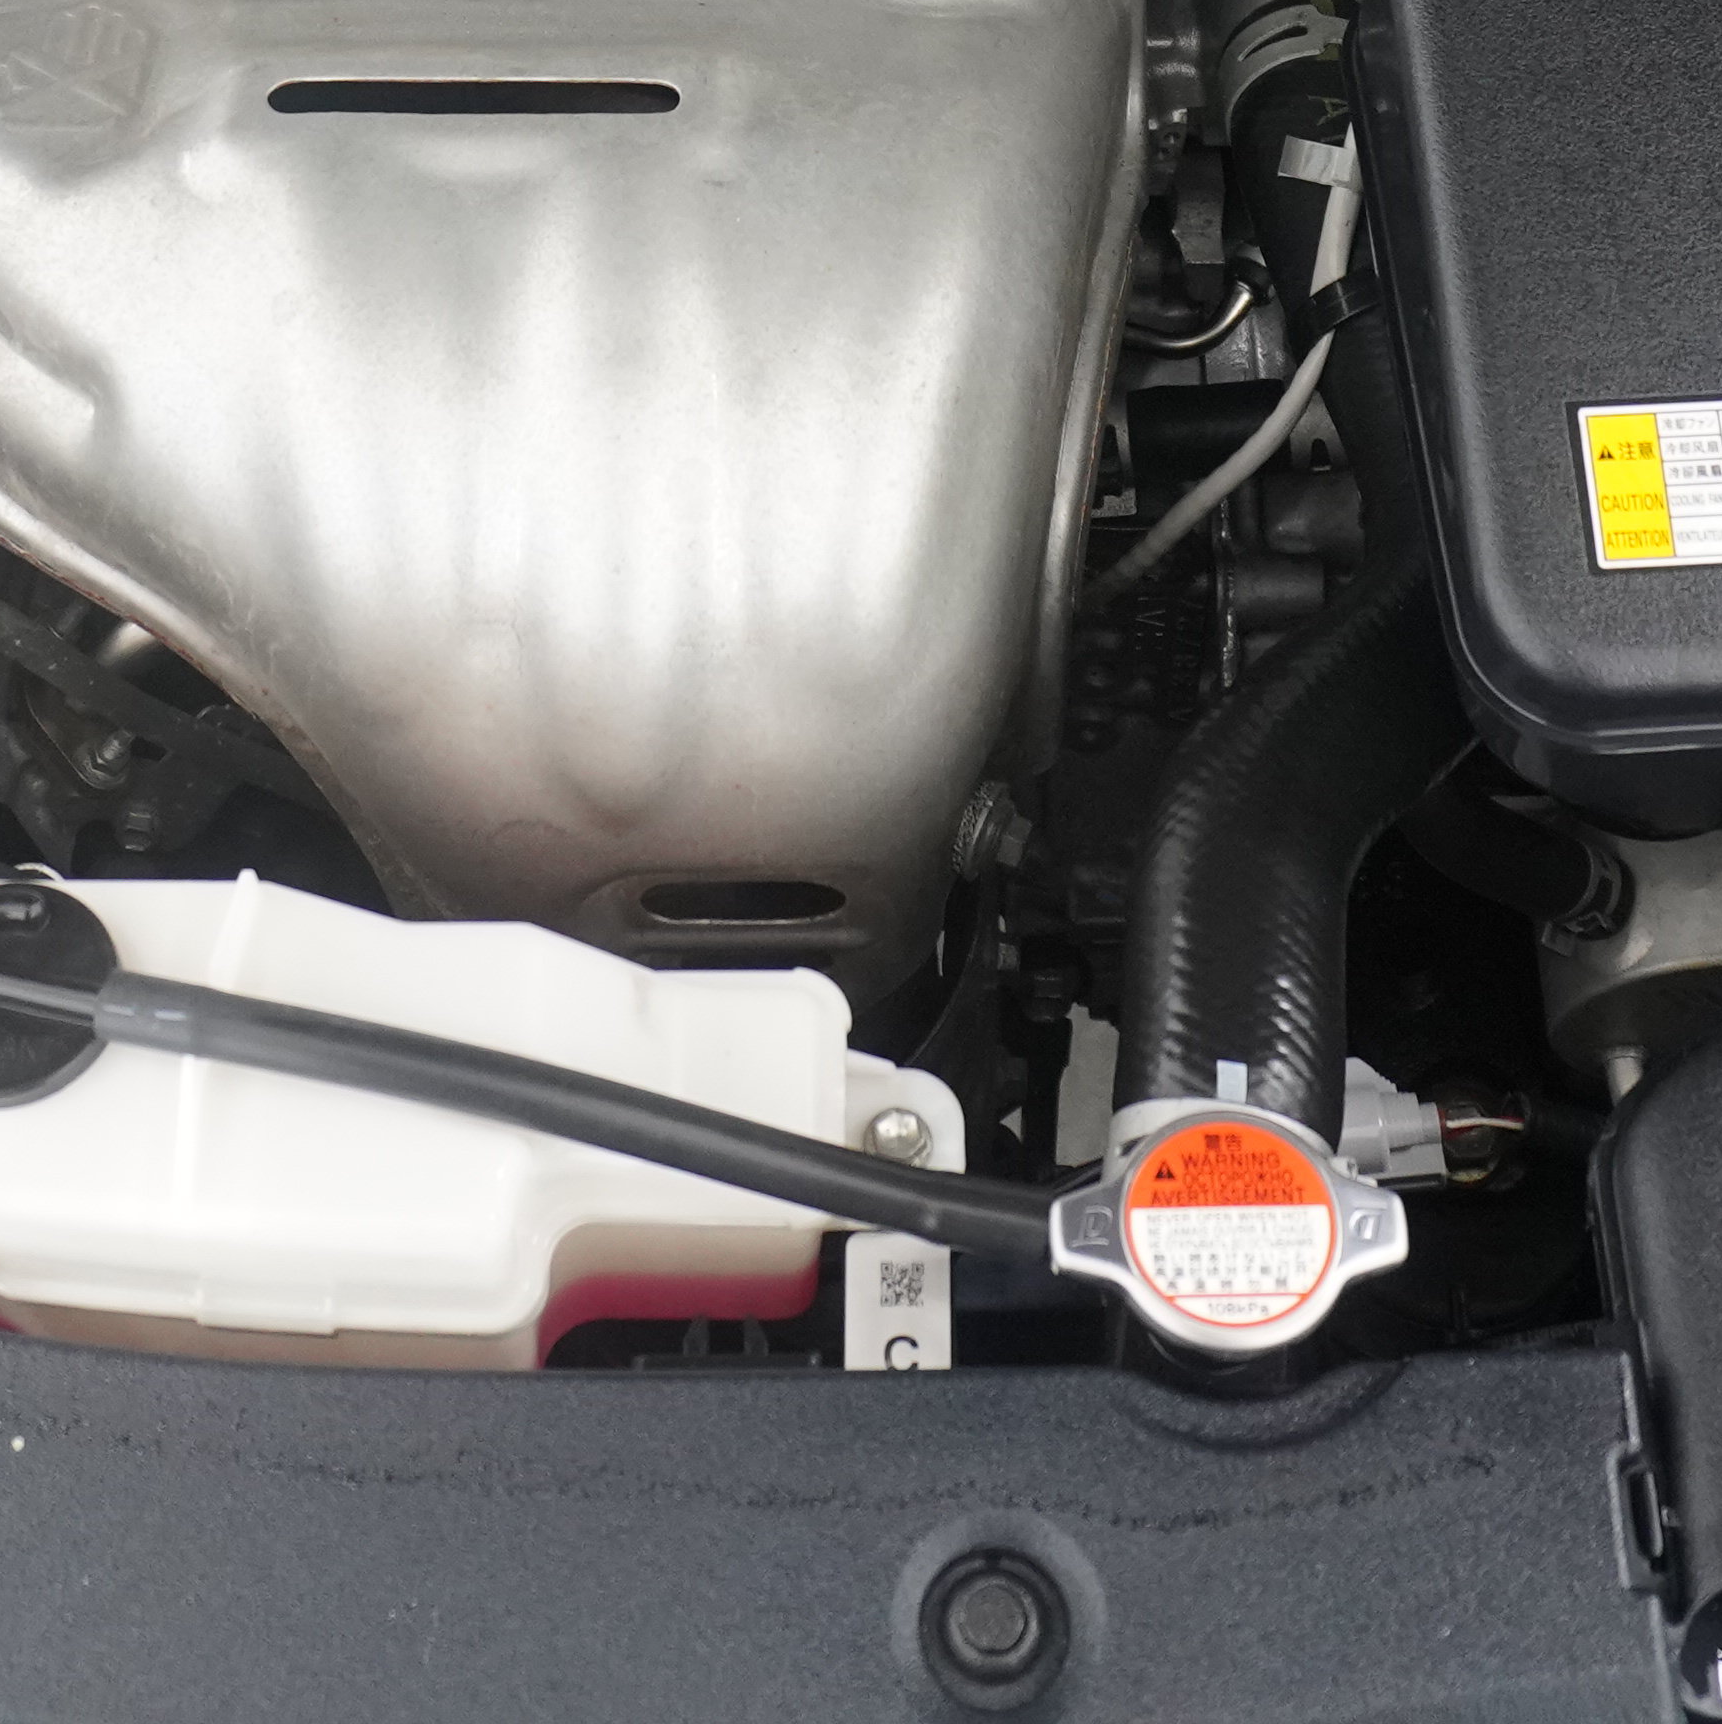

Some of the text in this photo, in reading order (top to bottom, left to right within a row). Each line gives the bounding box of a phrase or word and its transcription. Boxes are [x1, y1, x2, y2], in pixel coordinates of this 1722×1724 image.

[1618, 440, 1656, 461] 注意
[1600, 493, 1666, 513] CAUTION
[1605, 530, 1671, 549] ATTENTION
[1181, 1152, 1281, 1170] WARNING
[1150, 1187, 1304, 1206] AVERTISSEMENT
[1147, 1211, 1190, 1223] NEVER
[1197, 1211, 1232, 1223] OPEN
[1239, 1211, 1276, 1223] WHEN
